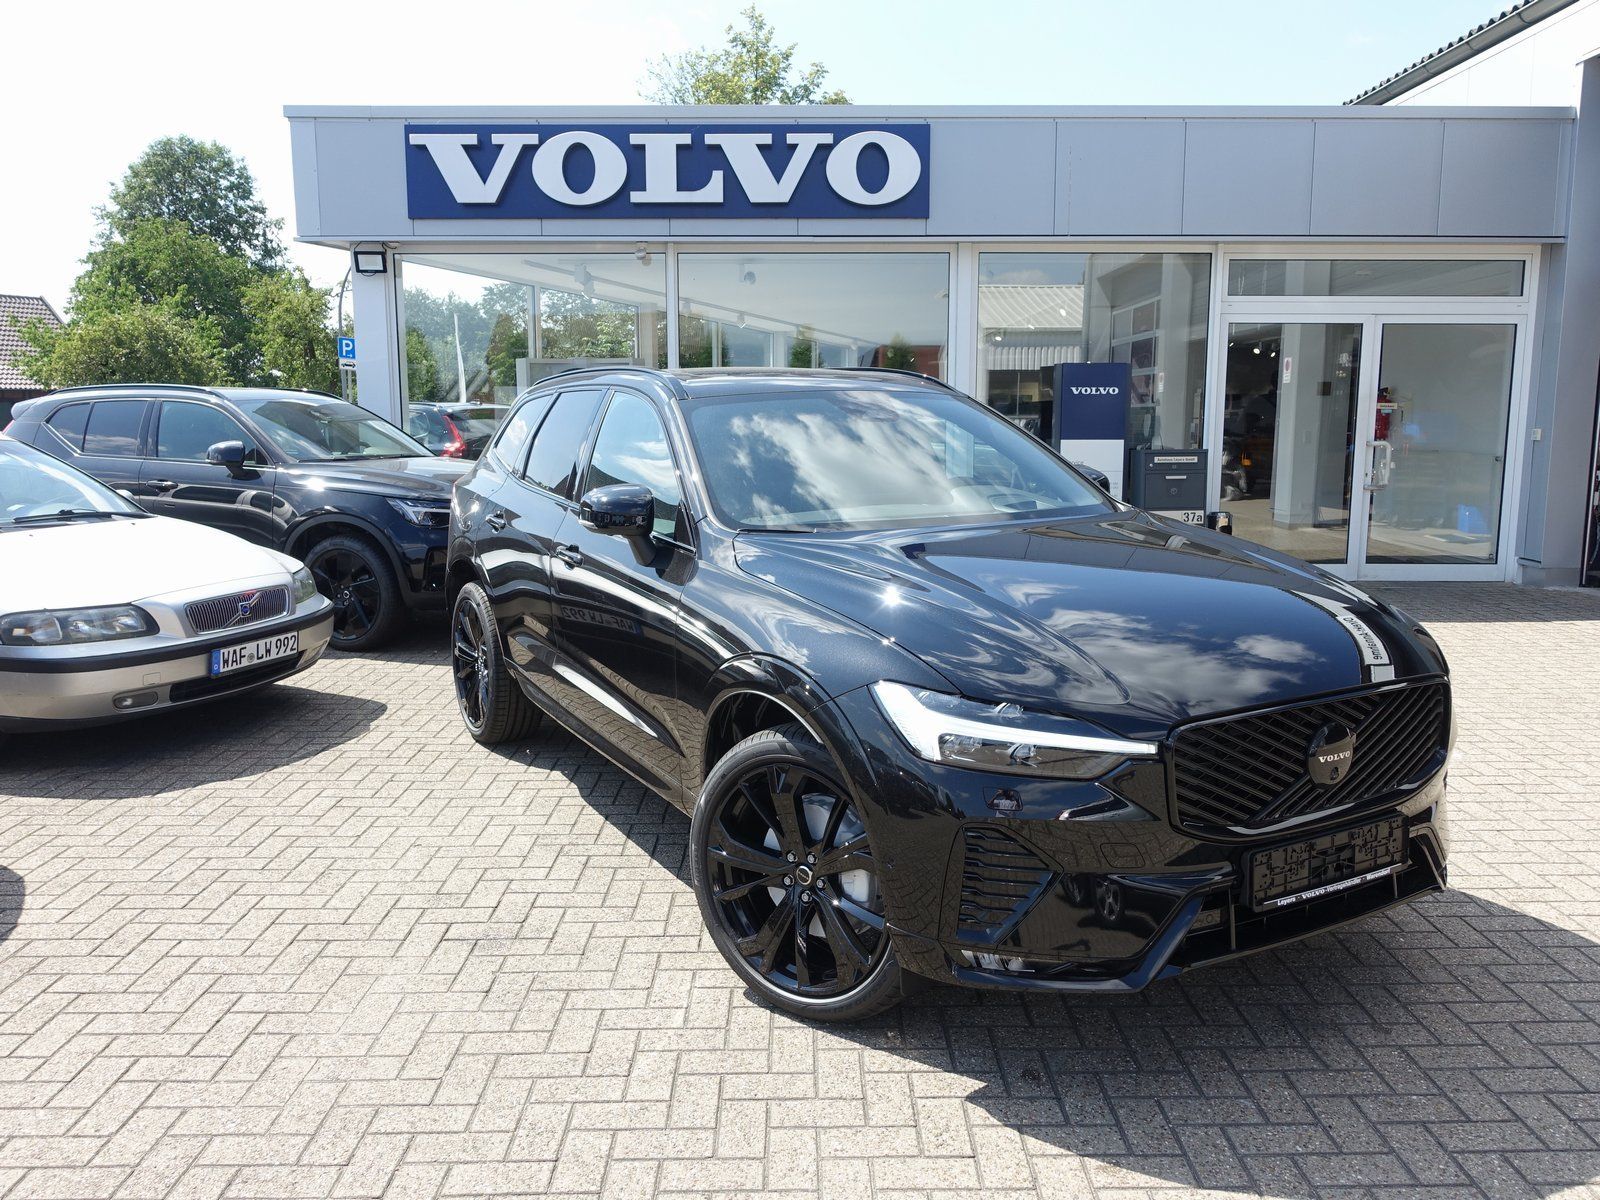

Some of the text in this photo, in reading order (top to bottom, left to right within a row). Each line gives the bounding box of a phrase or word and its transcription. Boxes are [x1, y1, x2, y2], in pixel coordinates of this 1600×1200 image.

[409, 130, 922, 206] VOLVO
[342, 339, 353, 356] P
[1070, 386, 1119, 395] VOLVO
[1183, 512, 1203, 523] 37a
[222, 635, 297, 669] WAF LW 992
[1318, 750, 1351, 763] VOLVO
